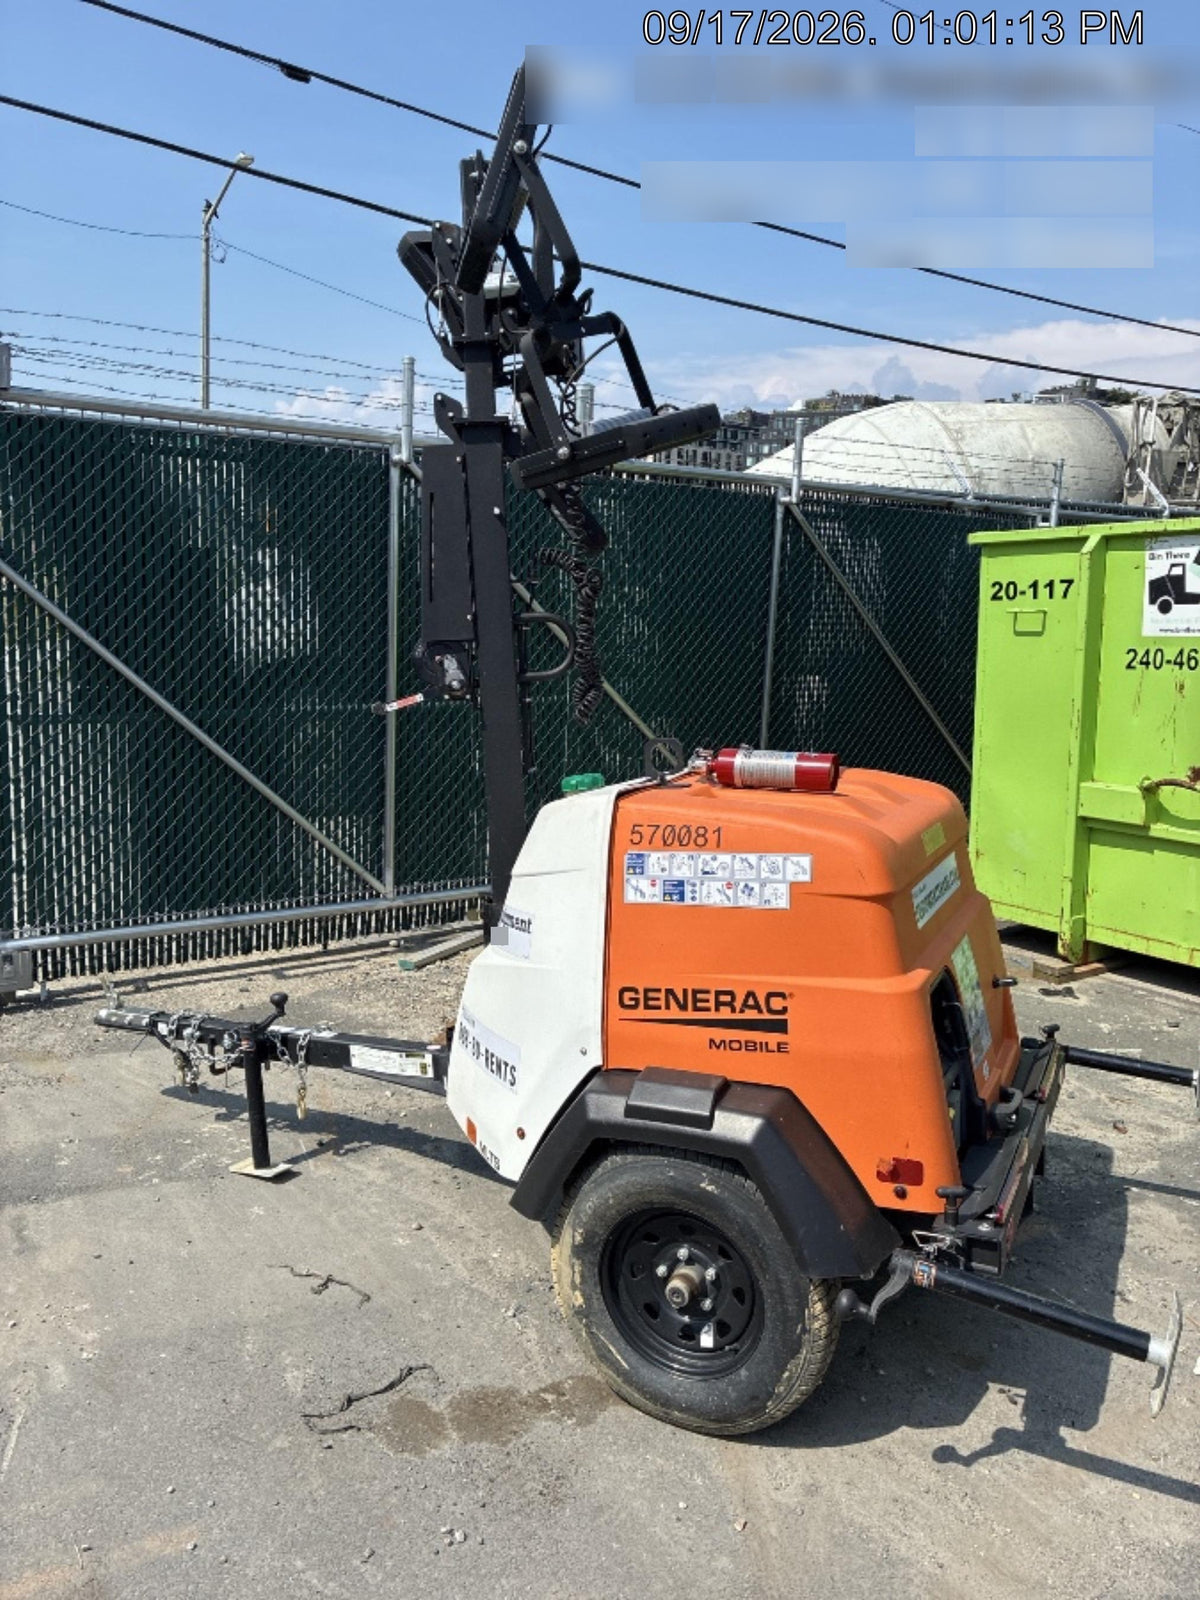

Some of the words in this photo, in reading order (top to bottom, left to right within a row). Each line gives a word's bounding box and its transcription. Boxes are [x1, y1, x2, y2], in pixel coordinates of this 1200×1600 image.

[990, 579, 1075, 601] 20-117
[1125, 648, 1199, 671] 240-46
[629, 824, 723, 849] 570081
[618, 986, 789, 1016] GENERAC
[708, 1038, 790, 1054] MOBILE
